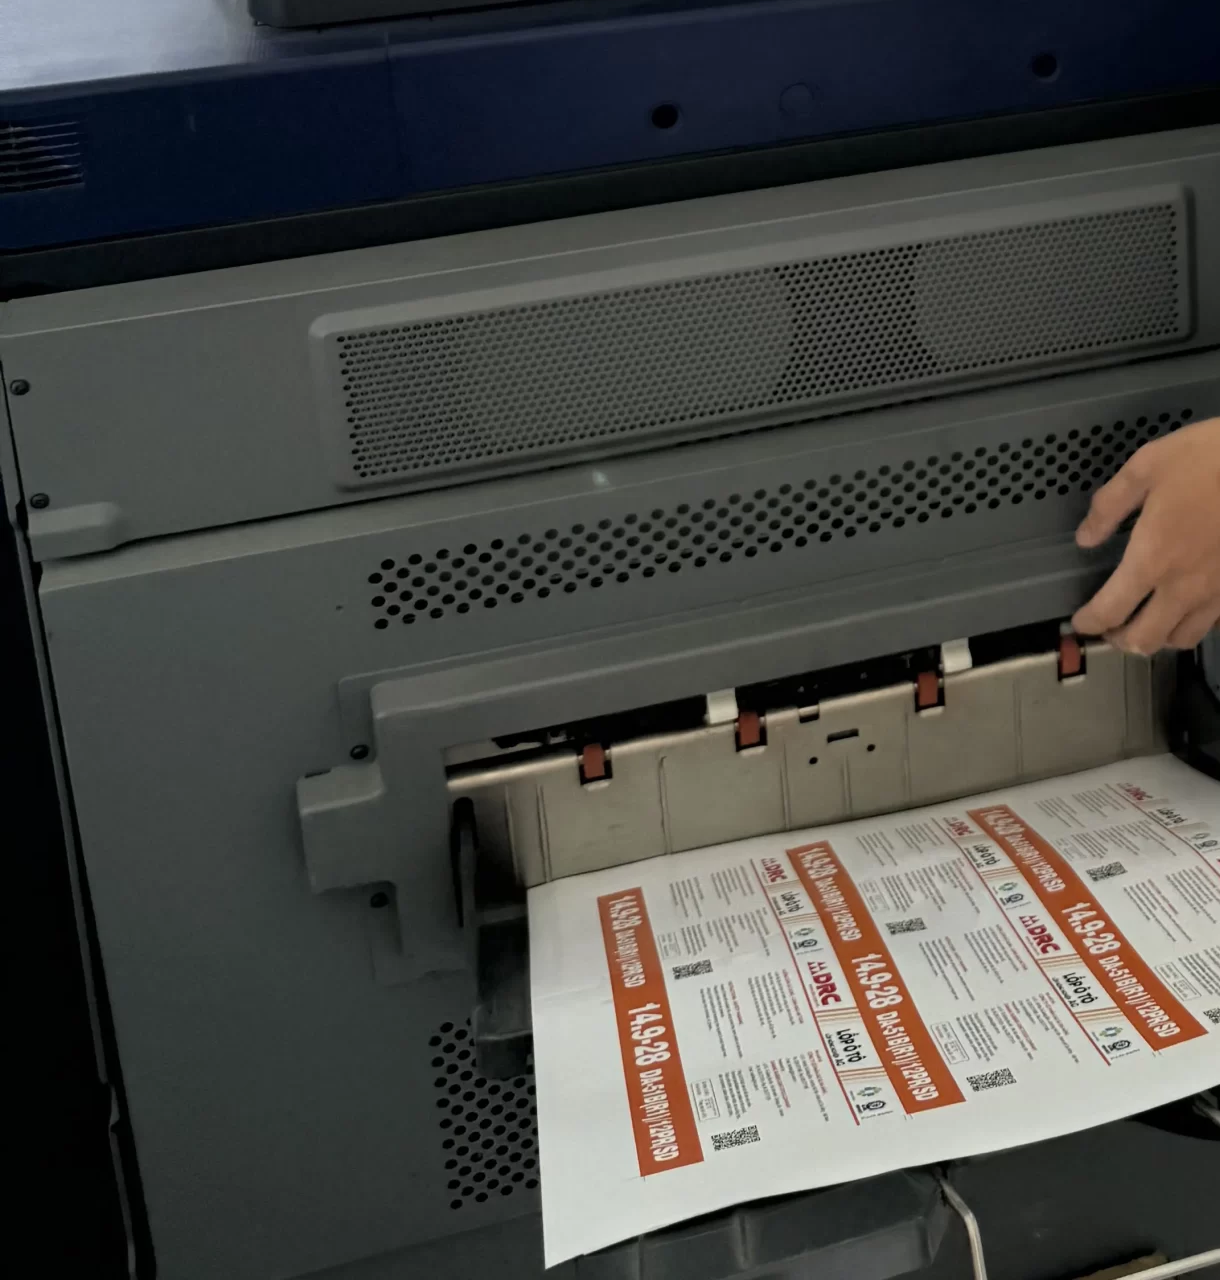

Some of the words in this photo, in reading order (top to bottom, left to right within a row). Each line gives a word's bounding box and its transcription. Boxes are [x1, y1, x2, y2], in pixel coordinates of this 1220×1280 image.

[764, 862, 787, 883] DRC
[798, 848, 838, 880] 14.9-28
[609, 896, 642, 931] 14.9-28
[1027, 926, 1060, 955] DRC
[852, 953, 903, 1009] 14.9-28
[1062, 903, 1120, 955] 14.9-28
[1098, 955, 1180, 1037] DA-51B(R1)/12PR/SD
[813, 973, 840, 1006] DRC
[1062, 972, 1086, 987] LỐP
[1077, 992, 1098, 1004] TÔ
[628, 1003, 671, 1066] 14.9-28
[836, 1028, 859, 1045] LỐP
[846, 1051, 866, 1063] TÔ
[876, 1011, 939, 1101] DA-51B(R1)/12PR/SD
[639, 1068, 679, 1162] DA-51B(R1)/12PR/SD
